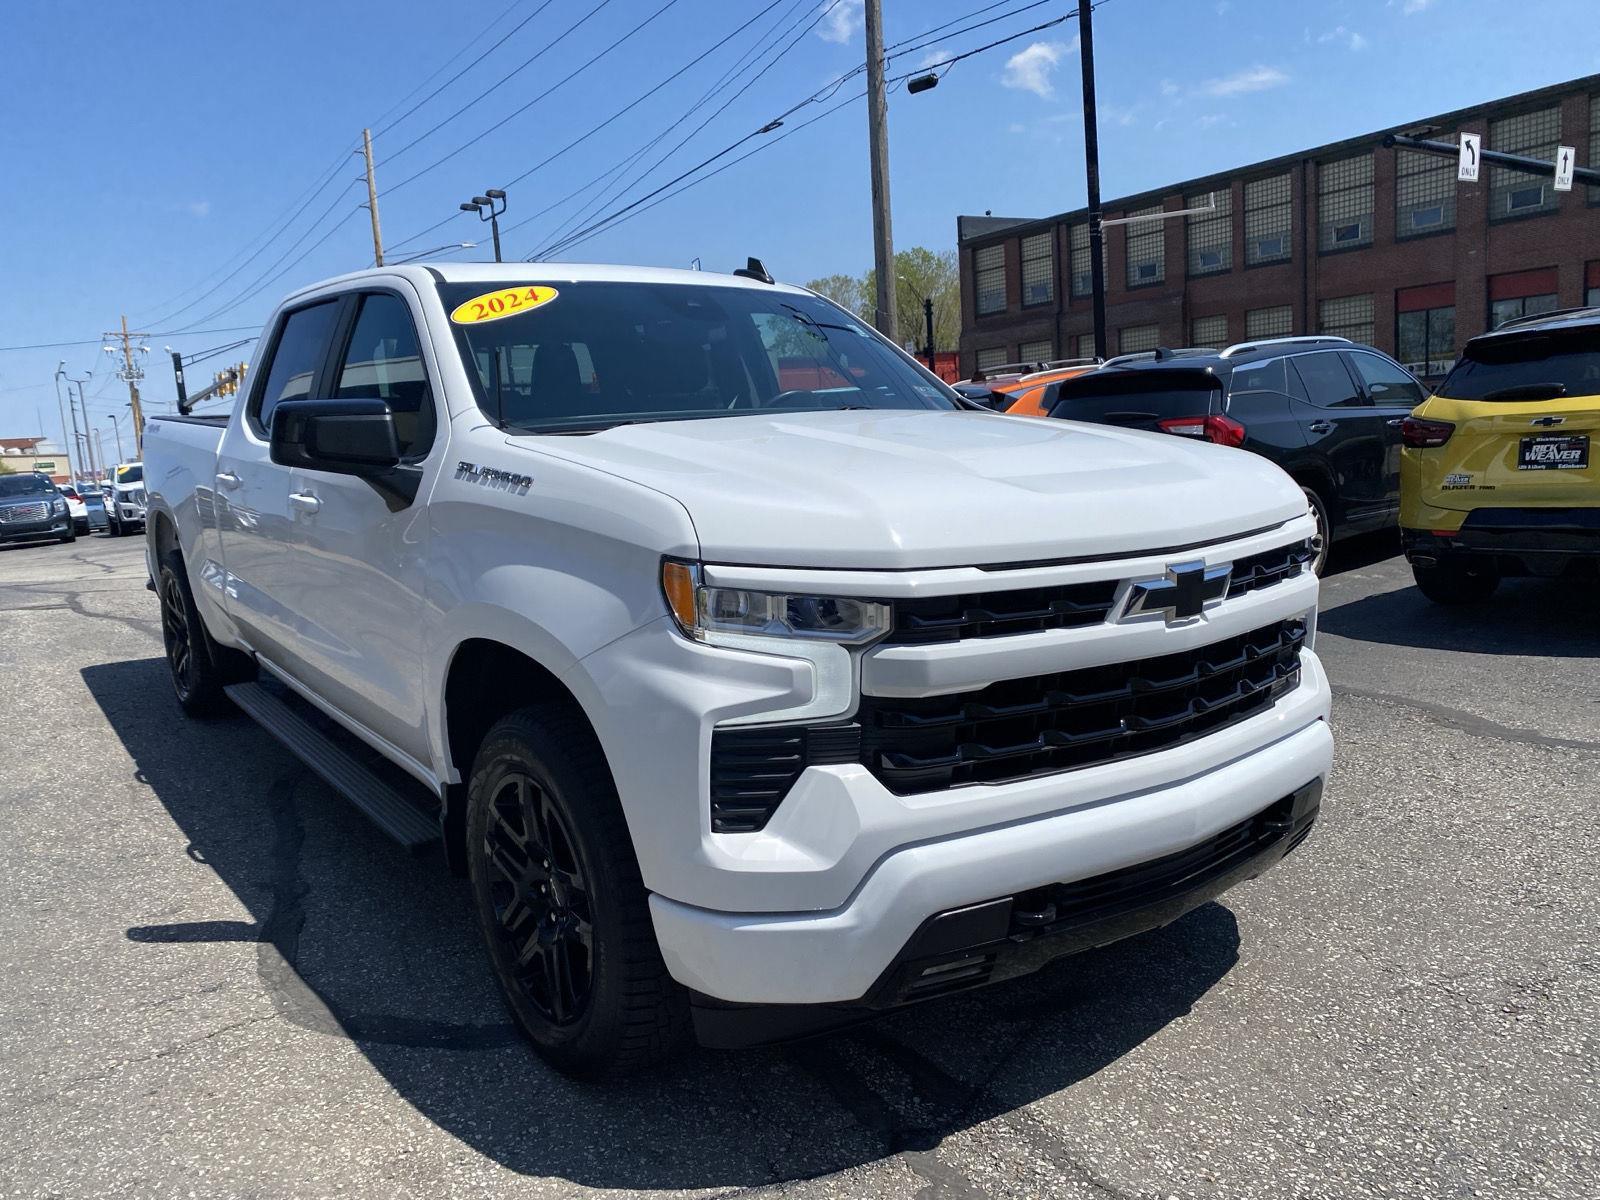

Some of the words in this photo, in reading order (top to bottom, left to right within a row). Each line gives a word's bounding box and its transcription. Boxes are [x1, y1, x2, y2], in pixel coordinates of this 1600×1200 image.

[1461, 167, 1476, 177] ONLY
[1557, 177, 1569, 185] ONLY
[470, 288, 539, 320] 2024
[1532, 443, 1558, 453] RICK
[1525, 450, 1581, 461] WEAVER
